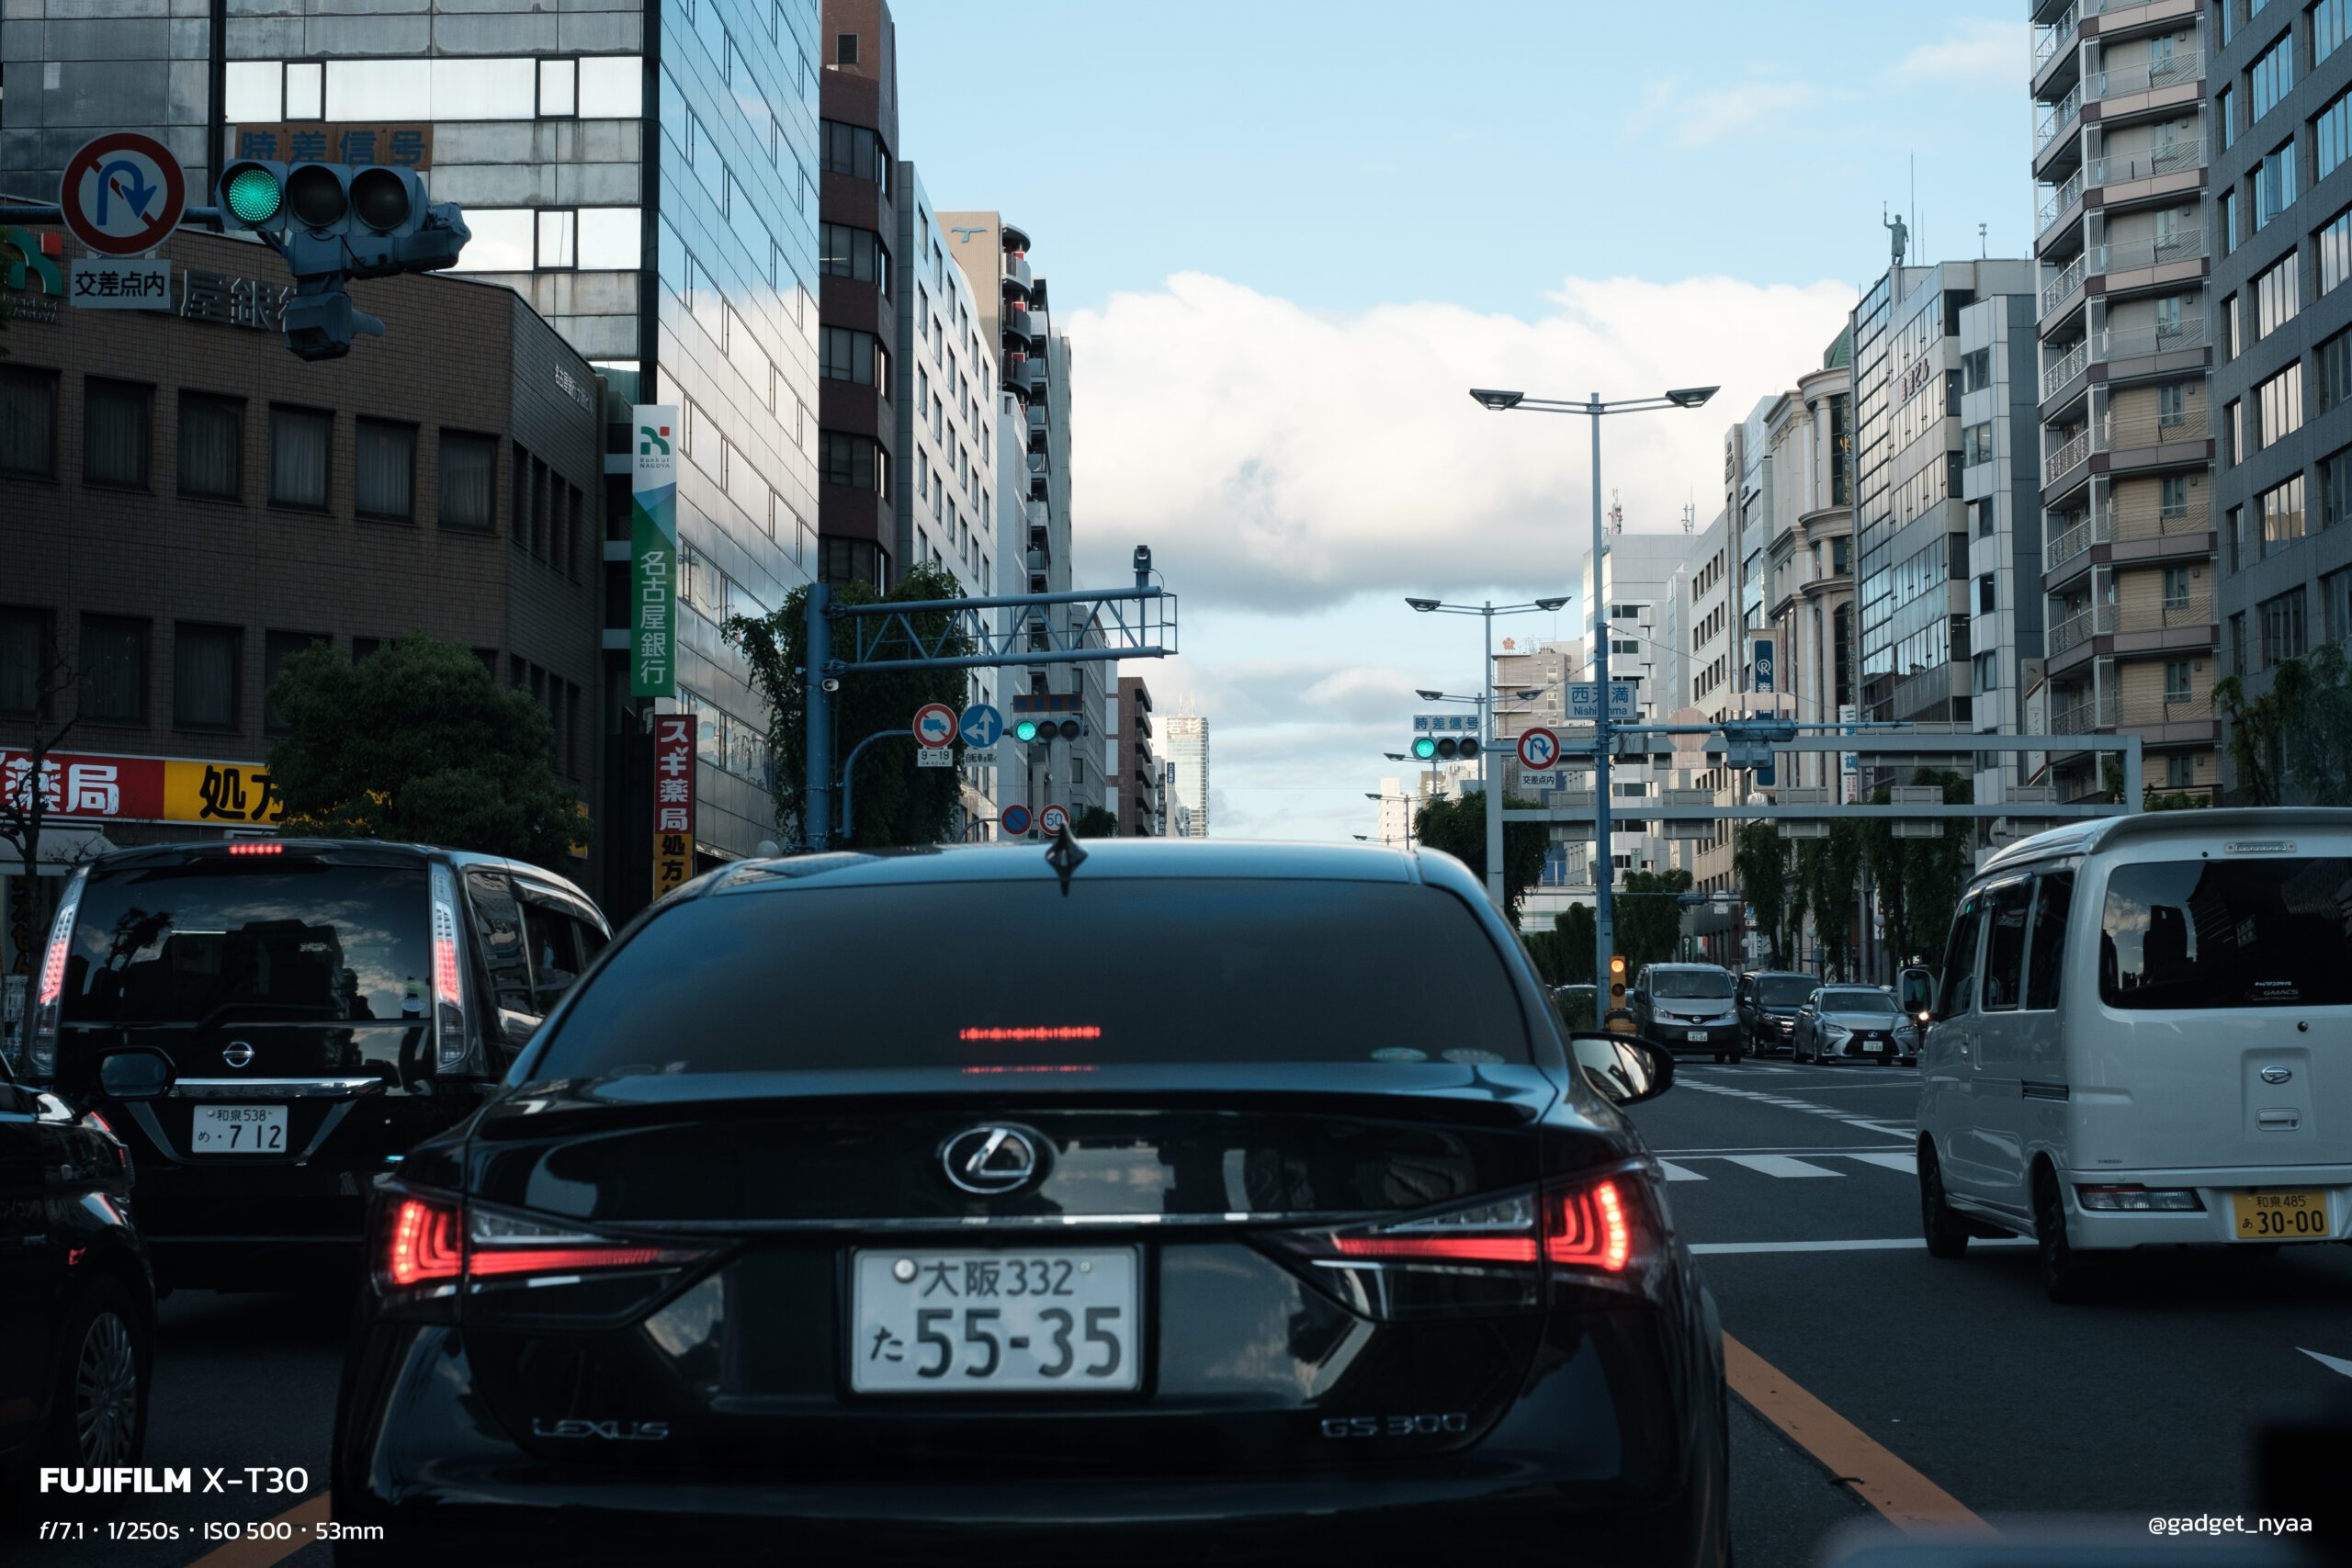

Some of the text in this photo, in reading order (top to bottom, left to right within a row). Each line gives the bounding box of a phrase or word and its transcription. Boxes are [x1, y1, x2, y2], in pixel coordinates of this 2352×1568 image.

[241, 130, 425, 165] 時差信号
[74, 271, 165, 297] 交差点内
[640, 551, 667, 684] 名古屋銀行
[1415, 716, 1479, 730] 時差信号
[660, 721, 689, 831] スギ薬局
[1522, 775, 1555, 785] 交差点内
[1046, 813, 1063, 827] 50
[661, 834, 685, 894] 処方
[198, 1131, 210, 1143] め
[2242, 1210, 2324, 1234] あ 30-00
[869, 1307, 1122, 1378] た 55-35
[531, 1417, 670, 1440] LEXUS
[1320, 1412, 1468, 1438] GS 300
